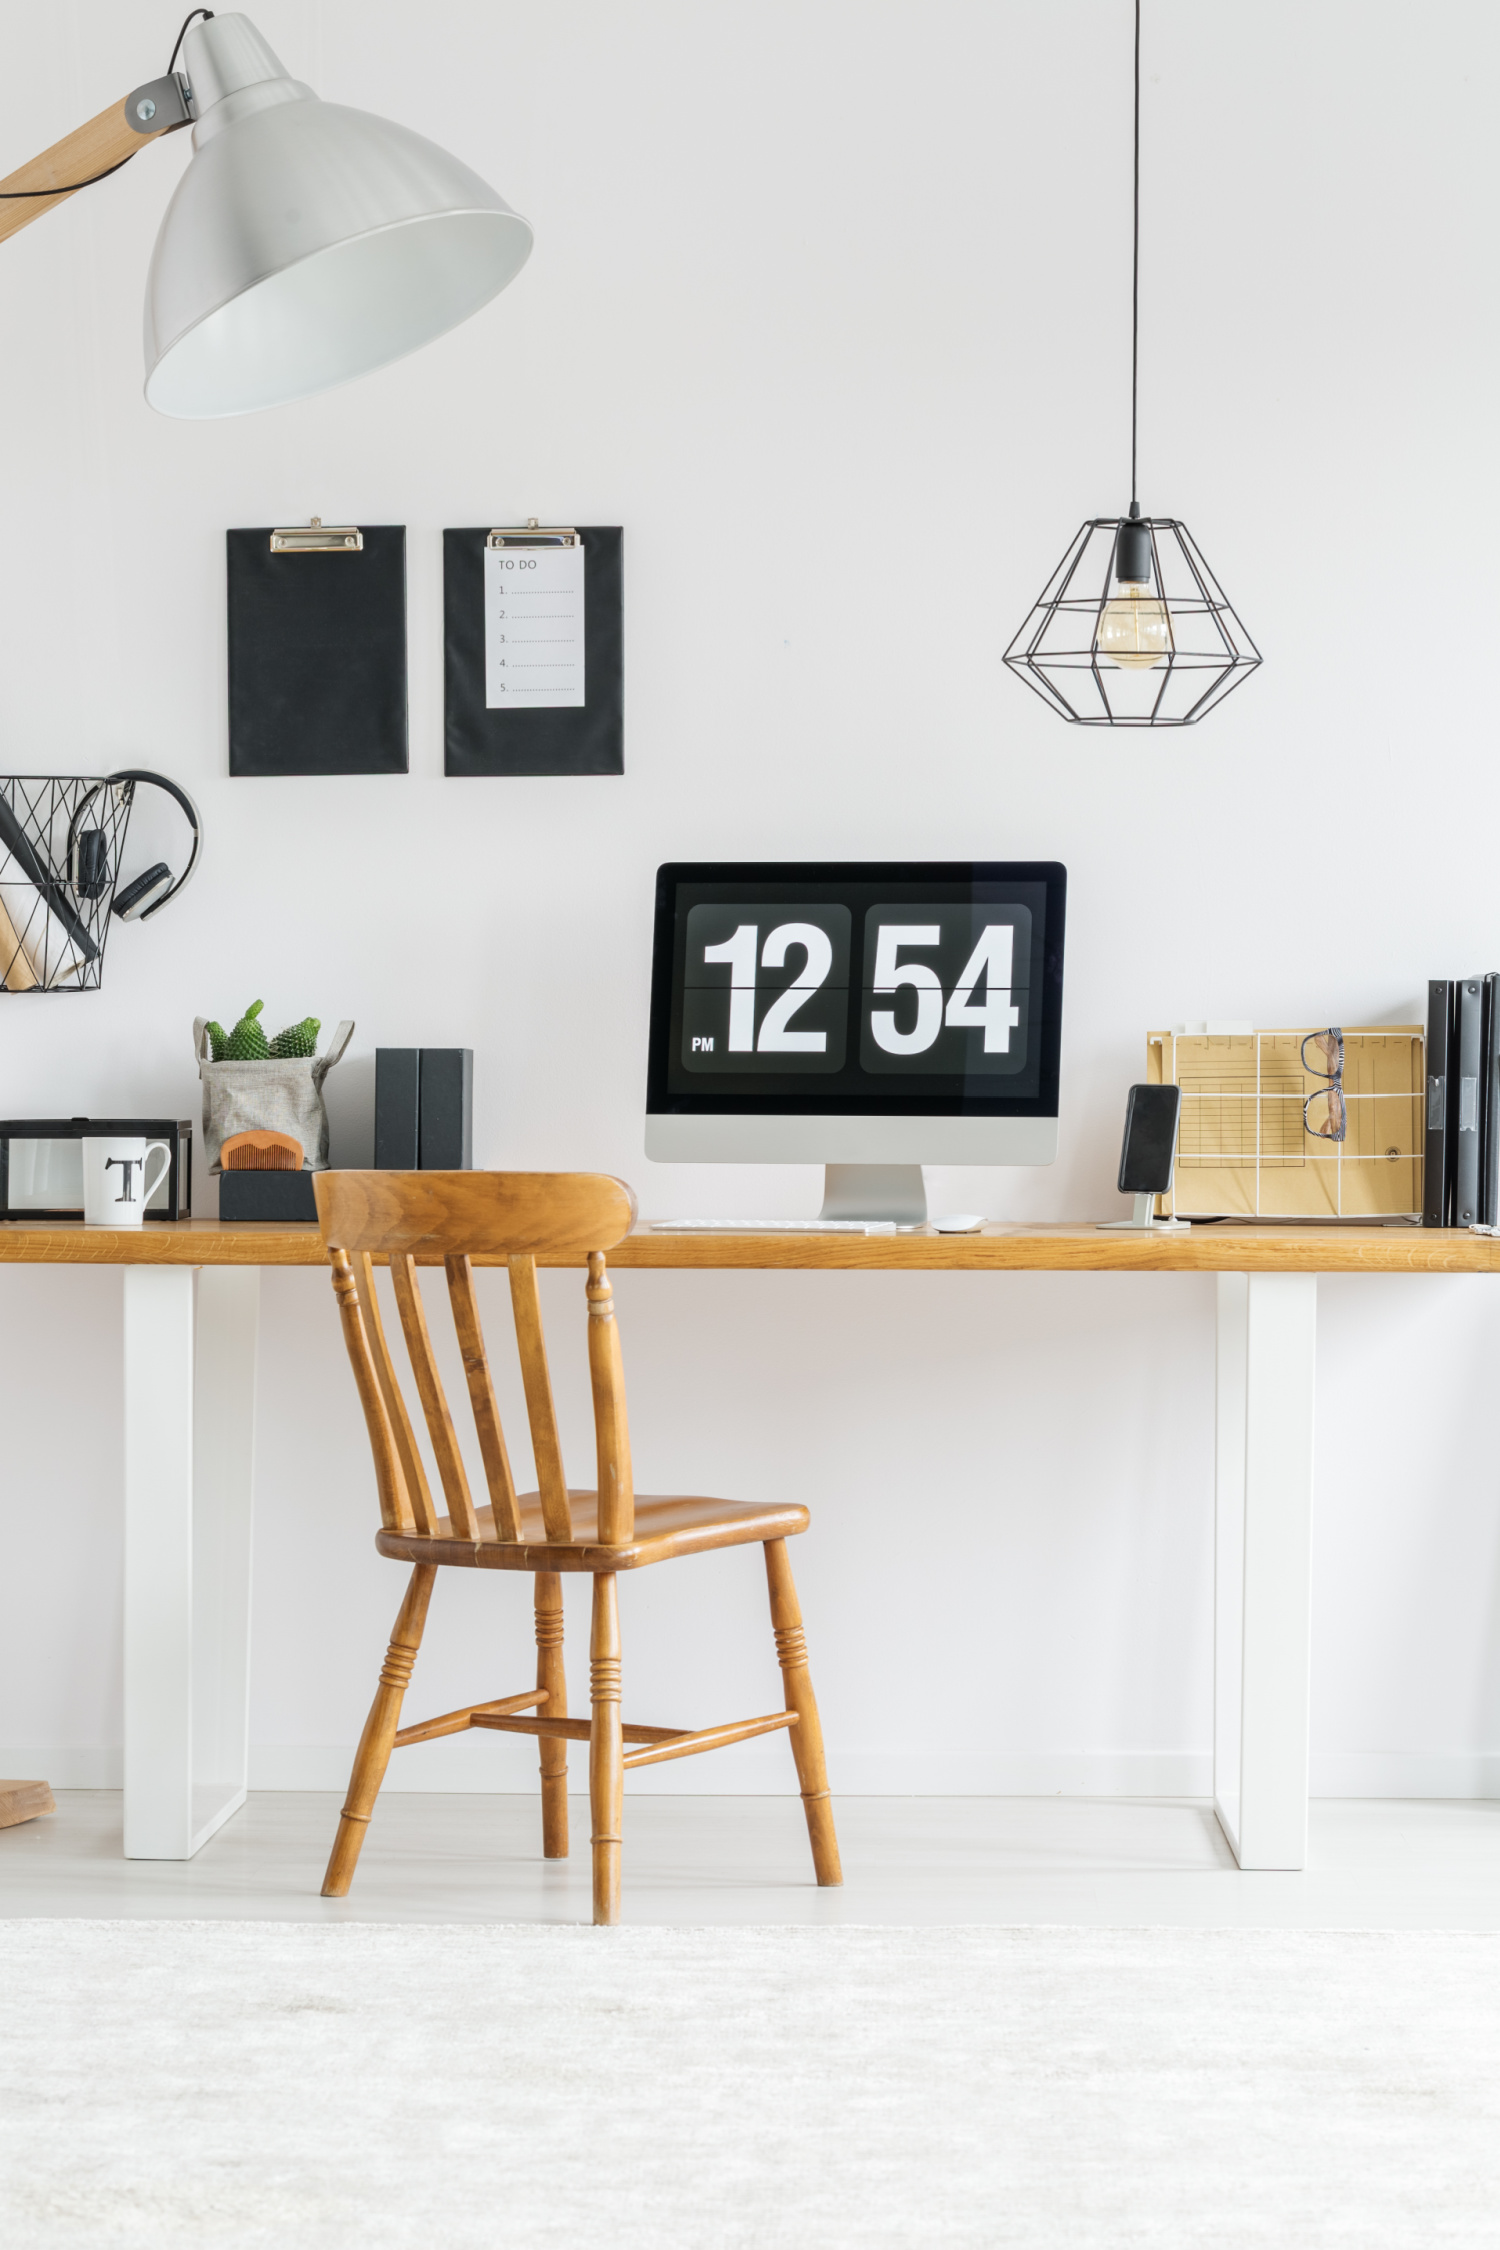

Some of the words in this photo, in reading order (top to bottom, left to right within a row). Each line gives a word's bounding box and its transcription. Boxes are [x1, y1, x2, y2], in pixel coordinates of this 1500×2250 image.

[498, 560, 515, 570] TO
[519, 560, 537, 570] DO
[499, 585, 508, 594] 1.
[499, 610, 508, 619] 2.
[499, 634, 509, 643] 3.
[499, 659, 509, 667] 4.
[500, 683, 509, 692] 5.
[704, 922, 833, 1053] 12
[871, 925, 1019, 1056] 54
[691, 1037, 714, 1052] PM
[105, 1157, 142, 1202] T
